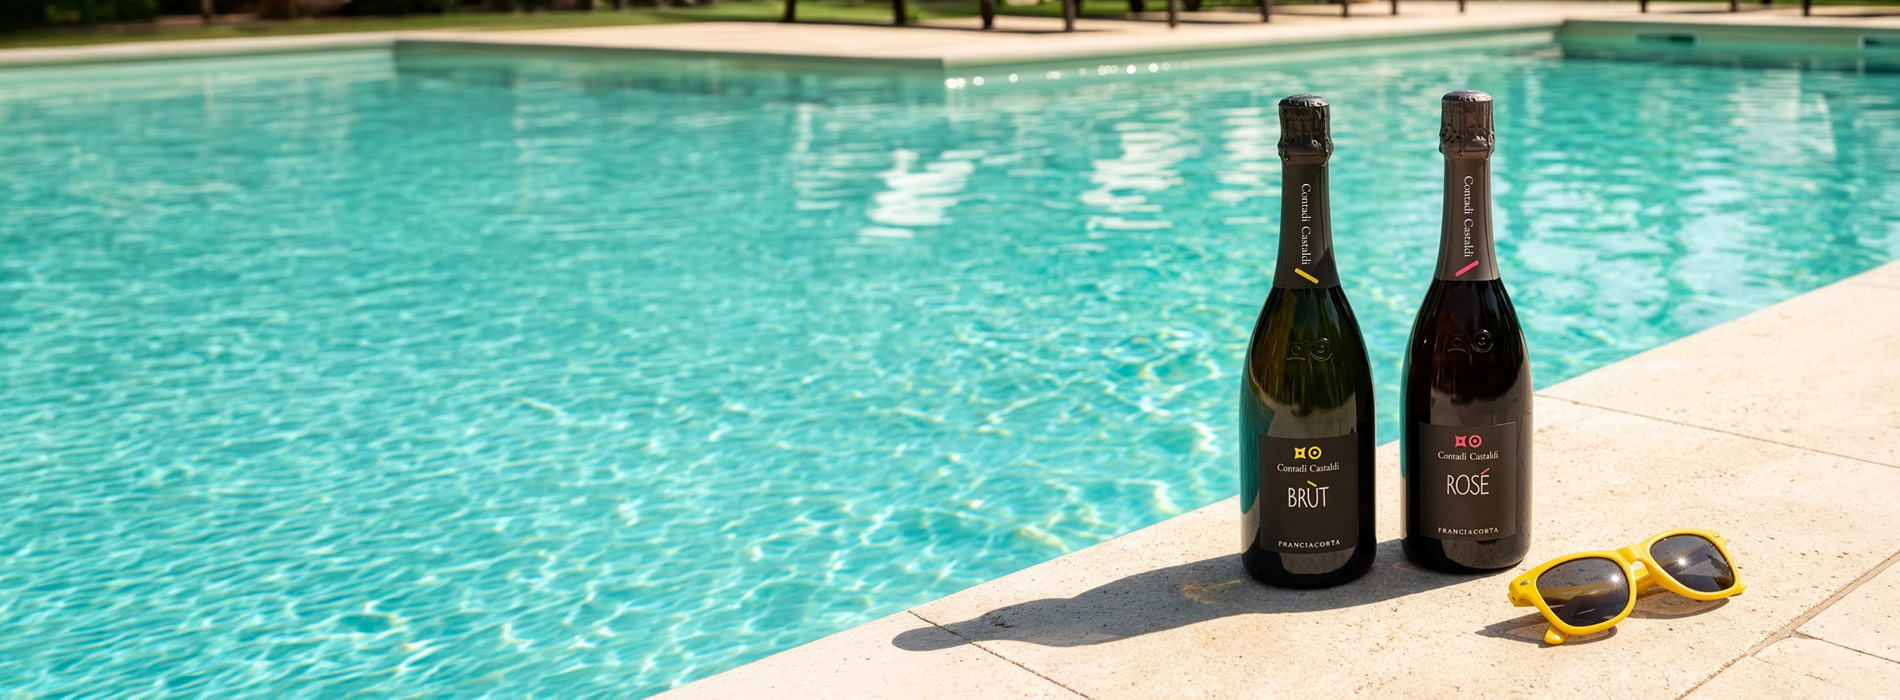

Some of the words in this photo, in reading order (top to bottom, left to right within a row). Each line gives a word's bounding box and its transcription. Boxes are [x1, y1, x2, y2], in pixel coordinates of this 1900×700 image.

[1301, 183, 1312, 222] Contadi
[1464, 175, 1474, 214] Contadi
[1301, 226, 1312, 265] Castaldi
[1464, 218, 1474, 257] Castaldi
[1309, 462, 1340, 473] Castaldi
[1437, 450, 1467, 461] Contadi
[1469, 450, 1499, 461] Castaldi
[1288, 480, 1329, 508] BRÙT
[1446, 467, 1490, 495] ROSÉ
[1278, 539, 1341, 549] FRANCIACORTA
[1438, 527, 1499, 535] FRANCIACORTA
